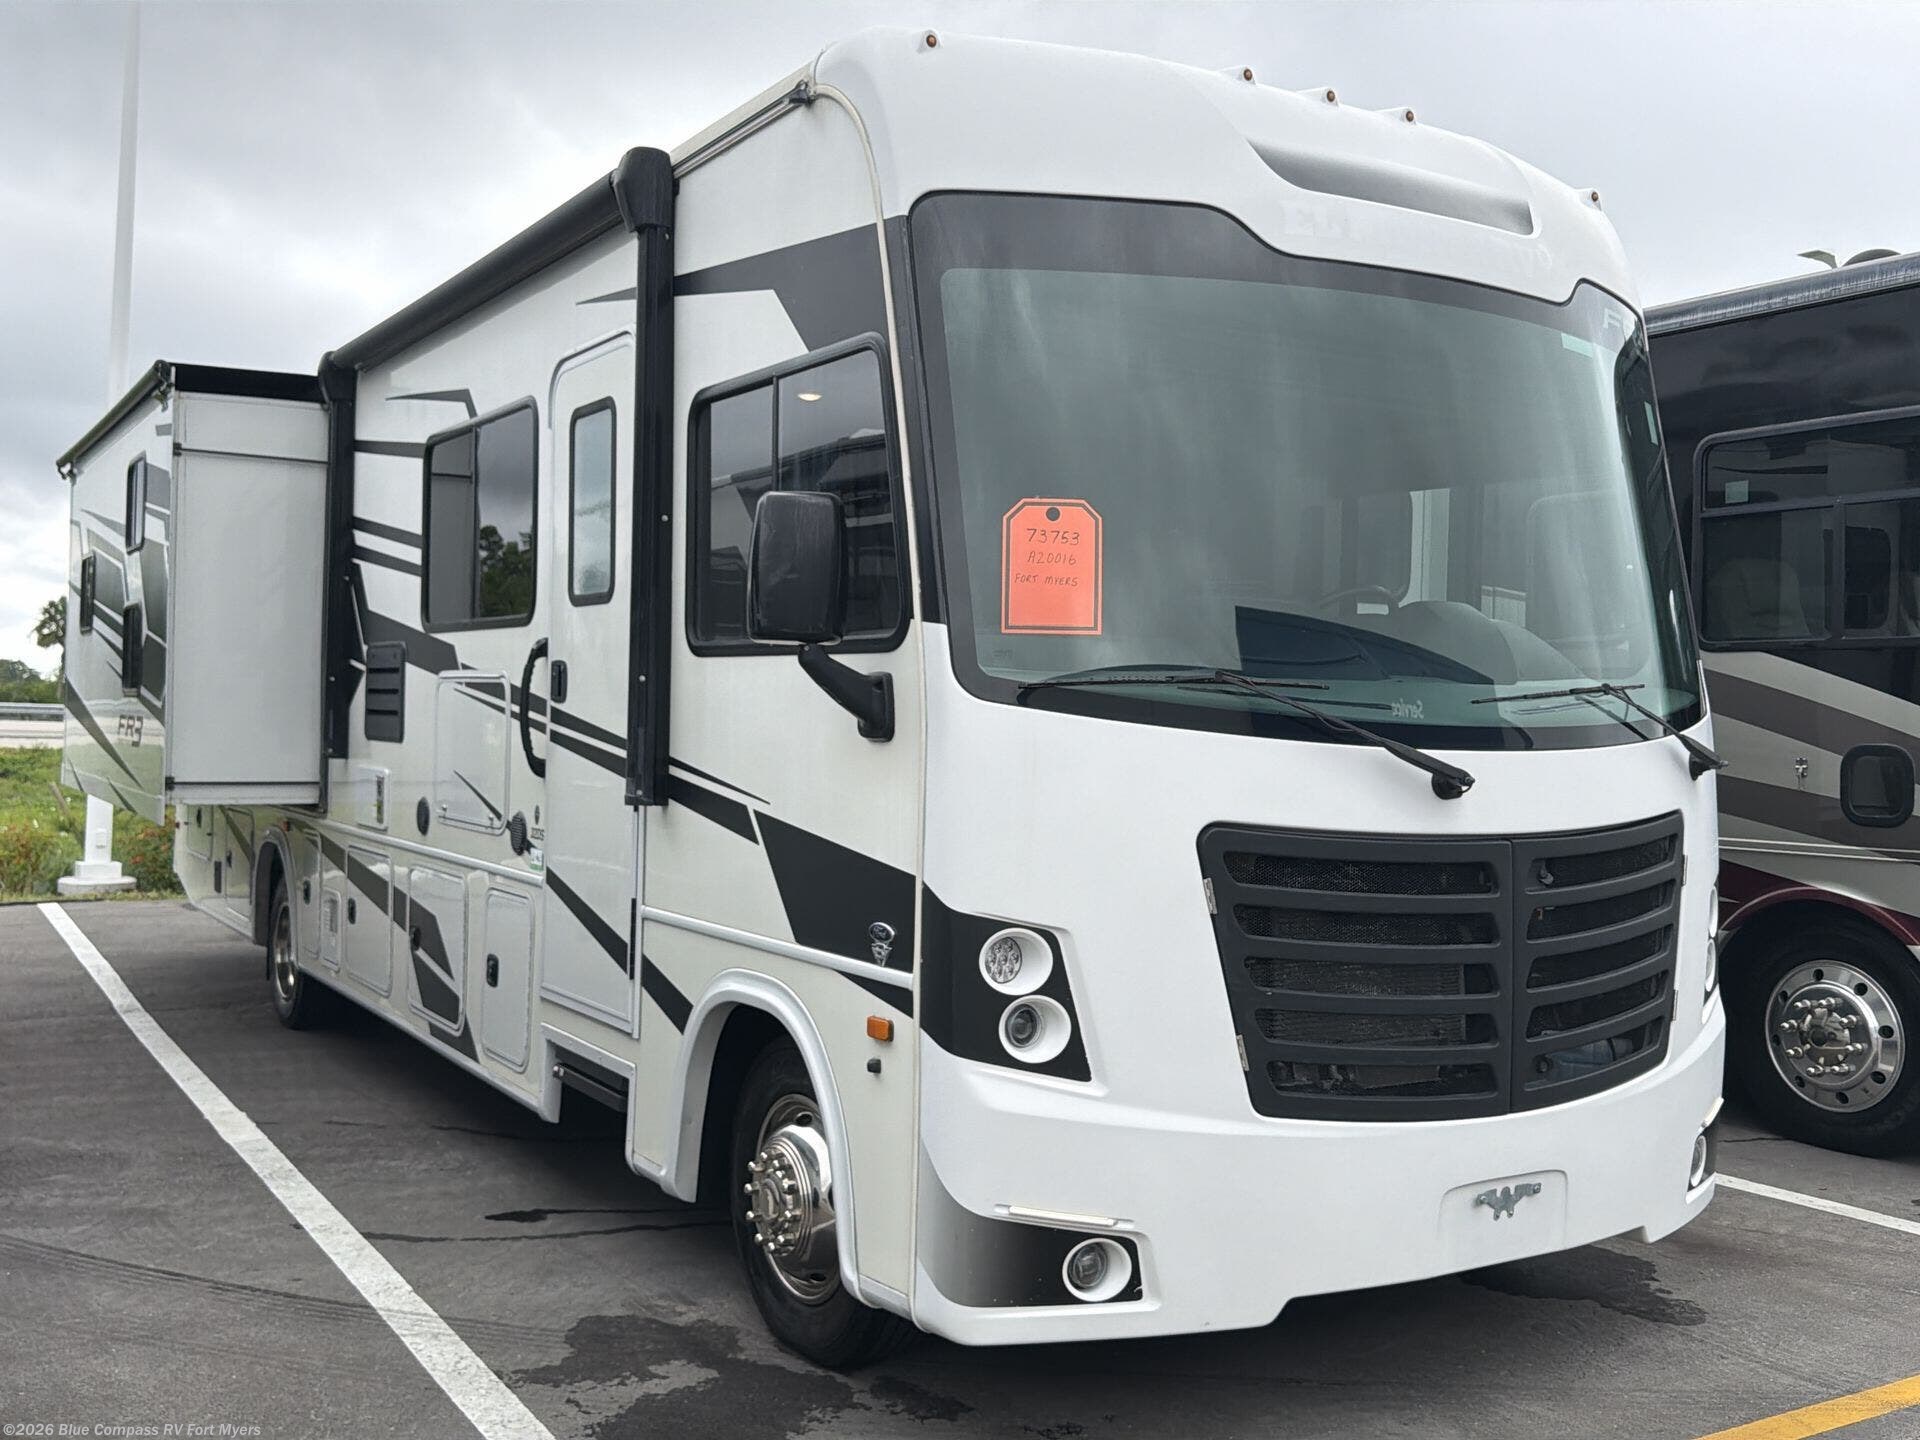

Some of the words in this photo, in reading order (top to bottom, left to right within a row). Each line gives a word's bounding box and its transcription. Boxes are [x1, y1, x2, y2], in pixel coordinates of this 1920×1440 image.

[1026, 528, 1080, 546] 73753
[1027, 550, 1077, 566] A20016
[1014, 572, 1039, 584] FORT
[1044, 575, 1079, 587] MYERS
[117, 713, 145, 748] FR3
